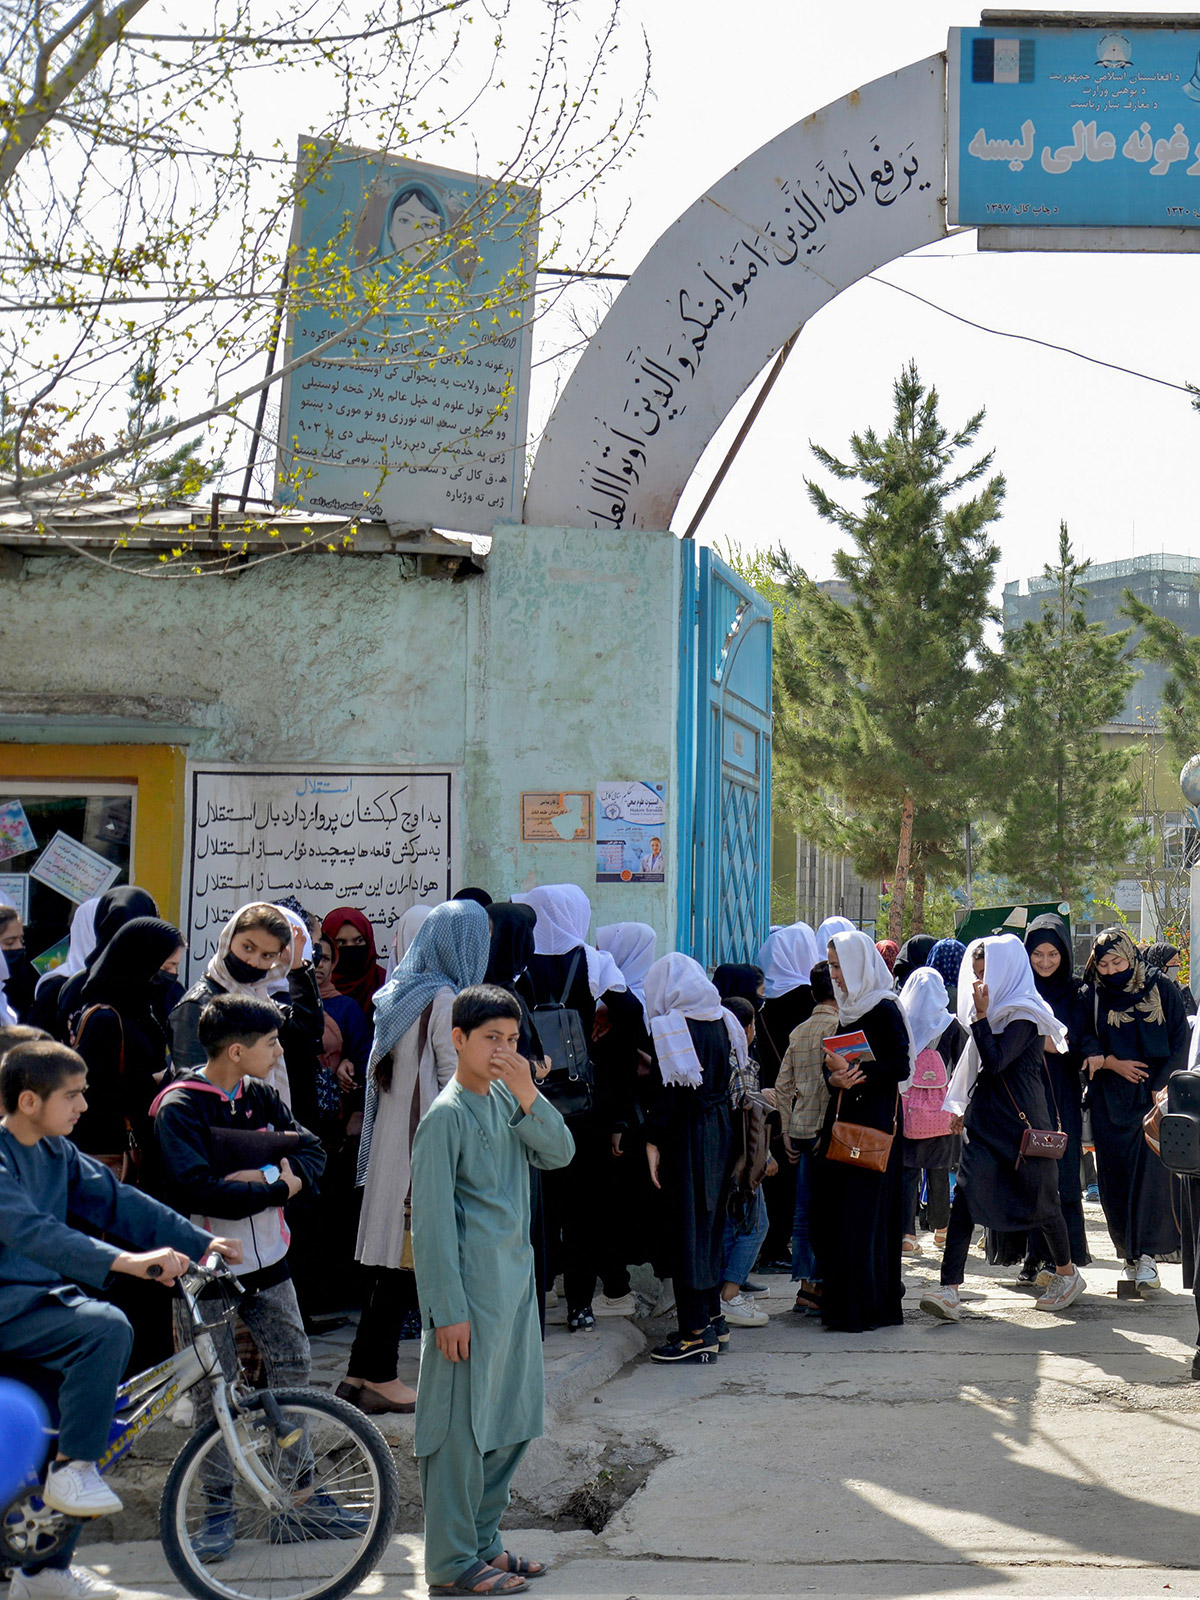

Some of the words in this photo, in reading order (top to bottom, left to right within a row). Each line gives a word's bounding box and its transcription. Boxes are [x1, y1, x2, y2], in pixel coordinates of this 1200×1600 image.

[968, 119, 1036, 171] لیسه
[296, 778, 353, 797] استقلال
[198, 800, 256, 828] استقلال
[197, 834, 255, 859] استقلال
[196, 872, 254, 897] استقلال
